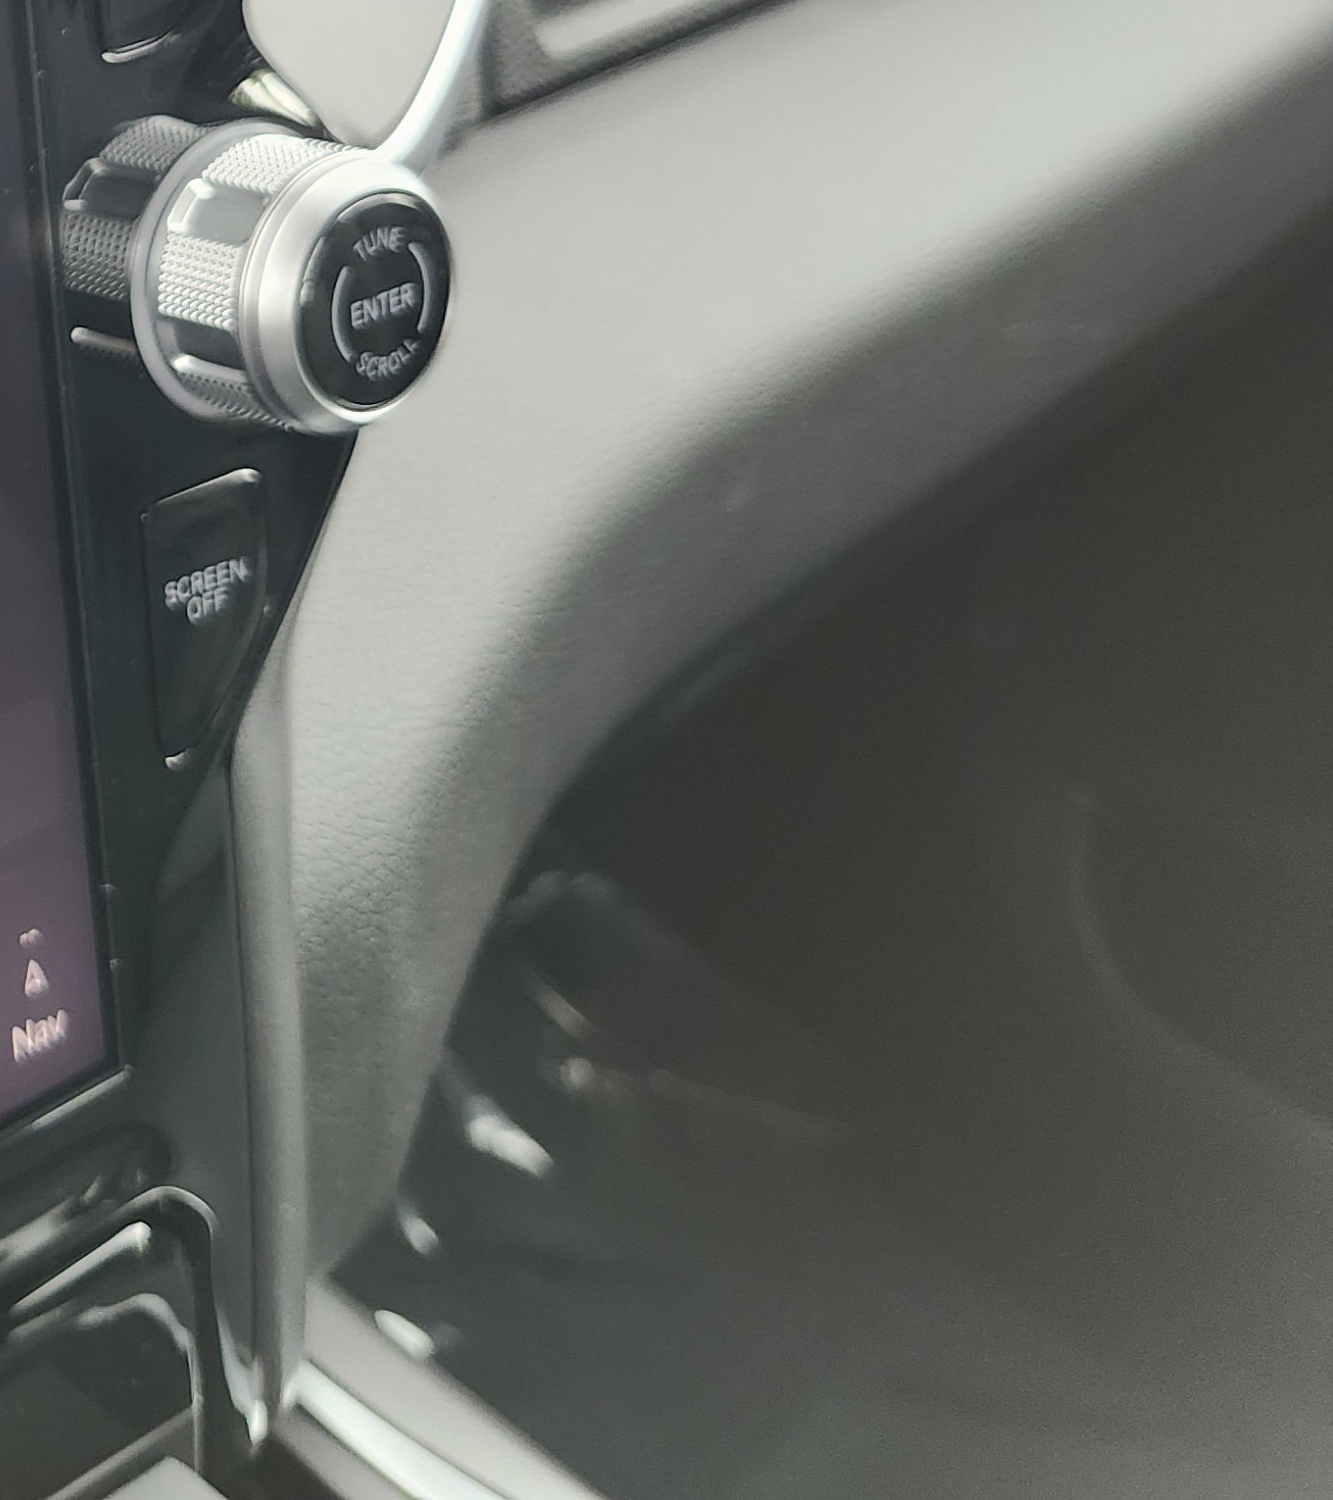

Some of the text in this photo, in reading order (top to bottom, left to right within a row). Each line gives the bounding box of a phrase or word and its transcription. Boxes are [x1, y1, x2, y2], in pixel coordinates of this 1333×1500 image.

[353, 226, 406, 261] TUNE
[350, 281, 419, 330] ENTER
[164, 556, 252, 611] SCREEN
[186, 586, 232, 626] OFF
[11, 1008, 71, 1065] Nav
